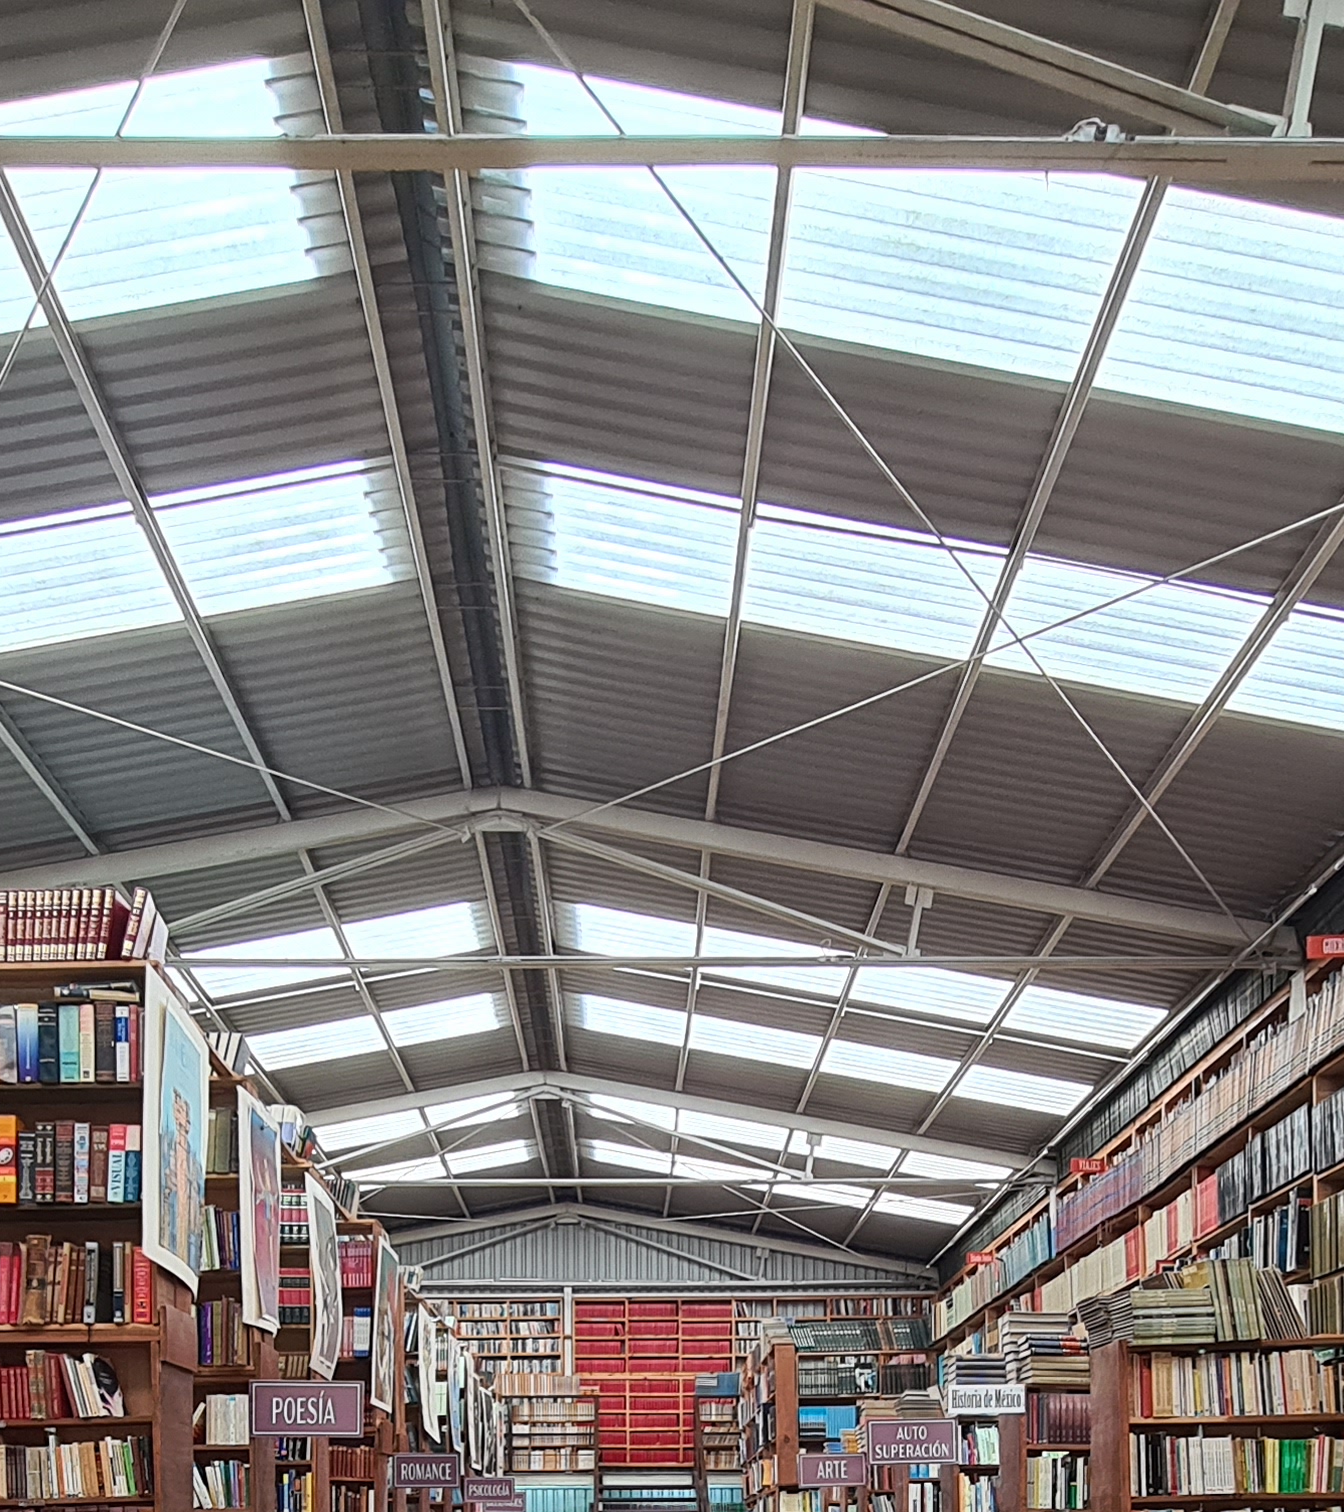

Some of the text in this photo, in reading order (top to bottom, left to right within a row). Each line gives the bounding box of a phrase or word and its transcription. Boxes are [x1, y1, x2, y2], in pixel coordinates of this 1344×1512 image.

[110, 1152, 123, 1191] VISUAL
[951, 1387, 1023, 1408] Historia de México
[271, 1391, 336, 1425] POESÍA
[896, 1426, 927, 1441] AUTO
[875, 1440, 950, 1459] SUPERACIÓN
[400, 1463, 453, 1481] ROMANCE
[816, 1460, 848, 1479] ARTE
[468, 1482, 510, 1497] PSICOLOGÍA
